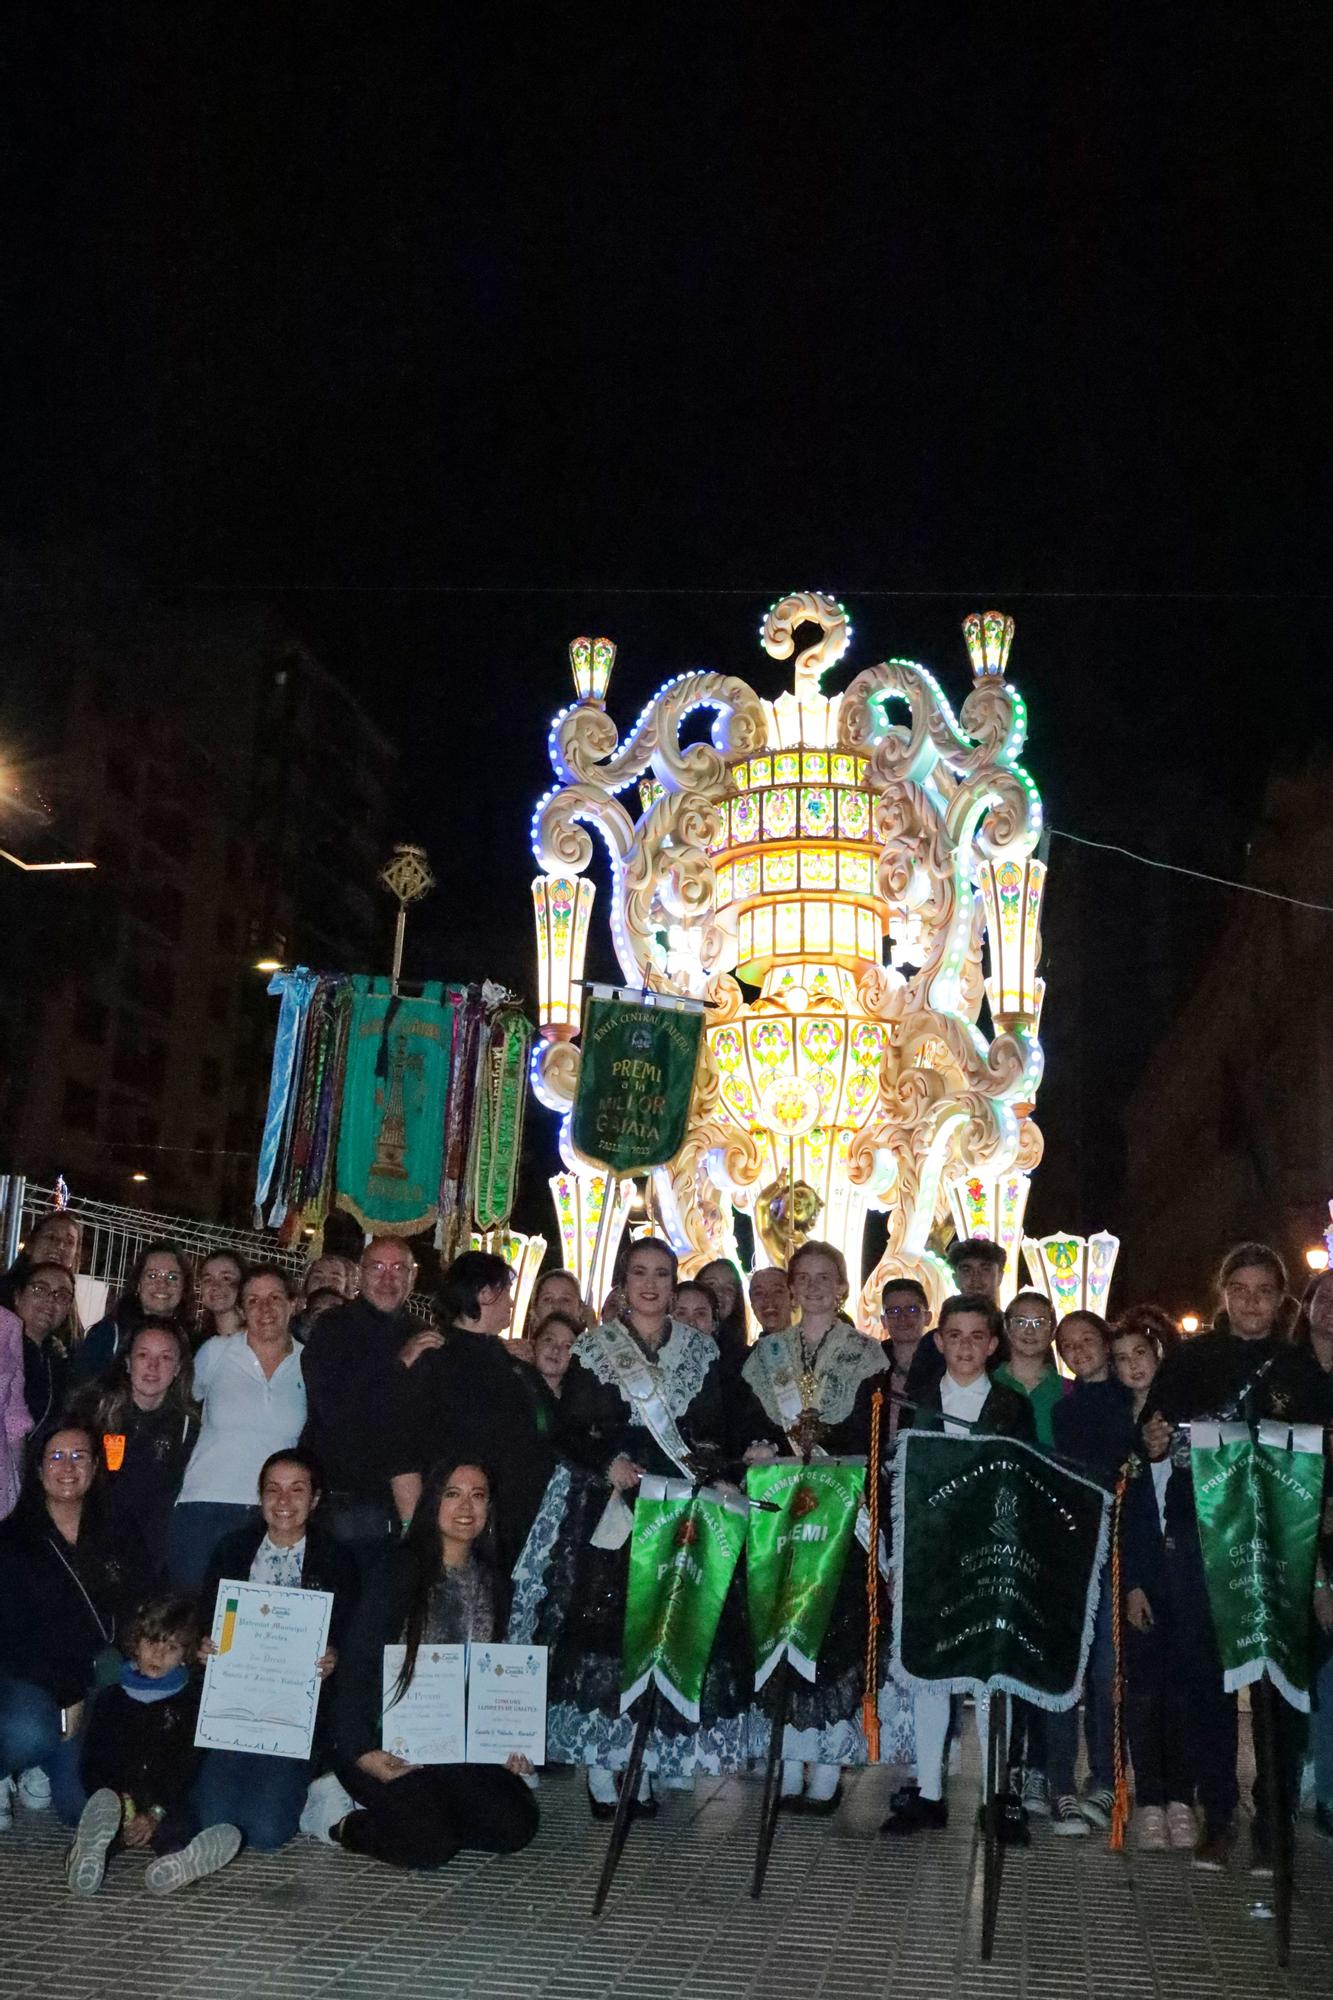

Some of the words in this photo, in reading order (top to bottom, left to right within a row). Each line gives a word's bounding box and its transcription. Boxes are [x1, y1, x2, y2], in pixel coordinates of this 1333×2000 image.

[612, 1059, 662, 1083] PREMI
[596, 1114, 660, 1142] GAIATA
[807, 1472, 817, 1480] DE
[1201, 1463, 1238, 1494] PREMI
[1238, 1453, 1314, 1502] GENERALITAT
[777, 1523, 828, 1554] PEMI
[657, 1551, 703, 1585] PEMI
